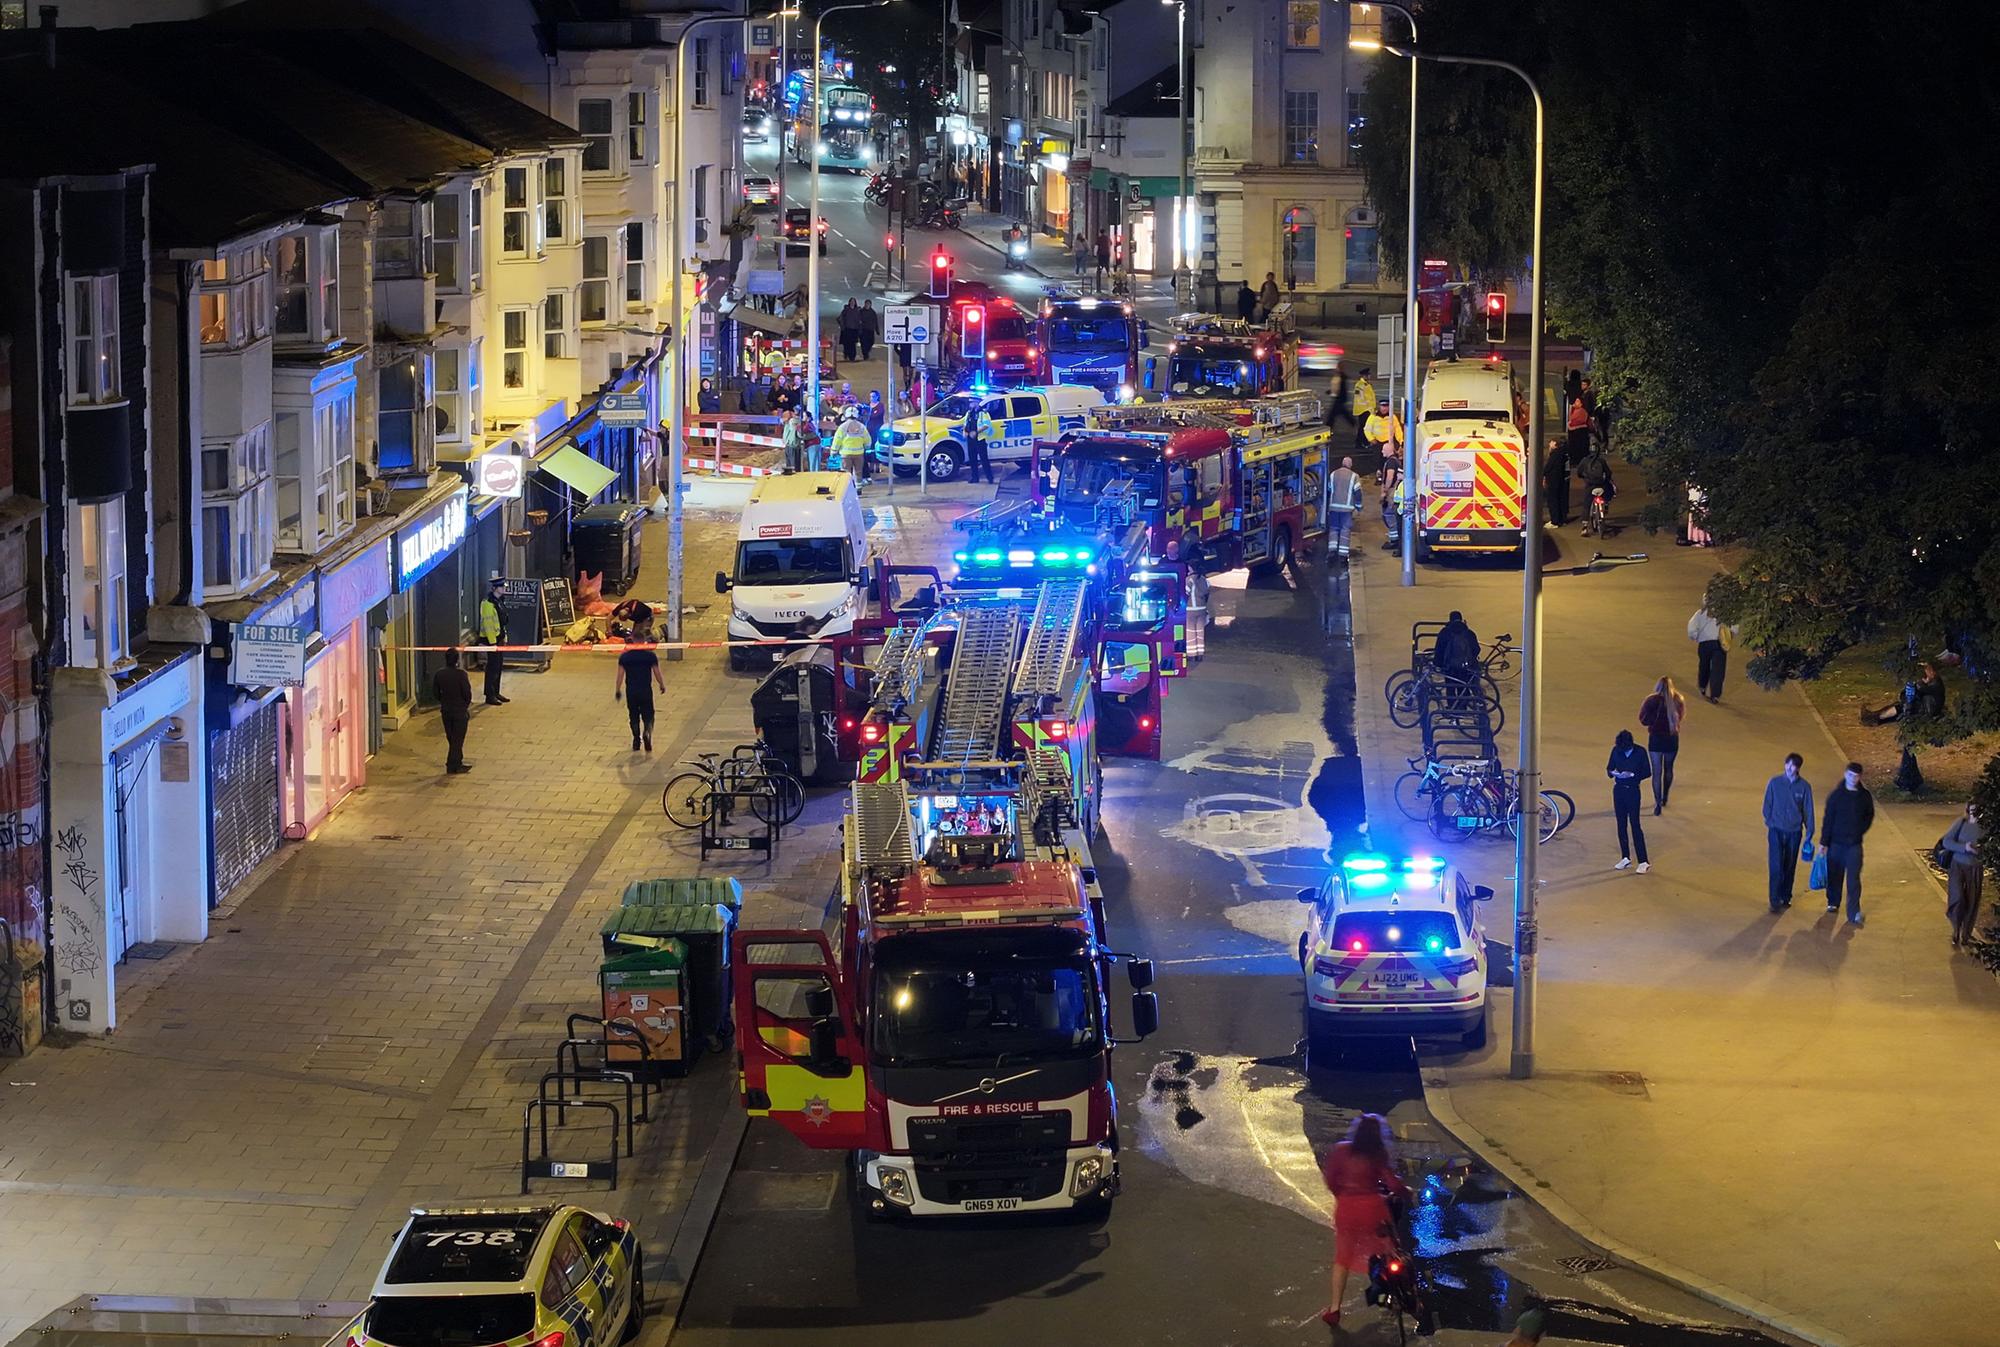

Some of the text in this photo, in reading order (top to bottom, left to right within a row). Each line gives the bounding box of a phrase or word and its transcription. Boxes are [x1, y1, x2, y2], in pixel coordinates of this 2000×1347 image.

[244, 626, 298, 642] FOR SALE
[114, 705, 145, 738] HELLO MY MOON
[1374, 973, 1418, 982] AJ22 UMG
[944, 1102, 1033, 1115] FIRE & RESCUE
[965, 1199, 1018, 1211] GN69 XOV
[426, 1232, 517, 1247] 738
